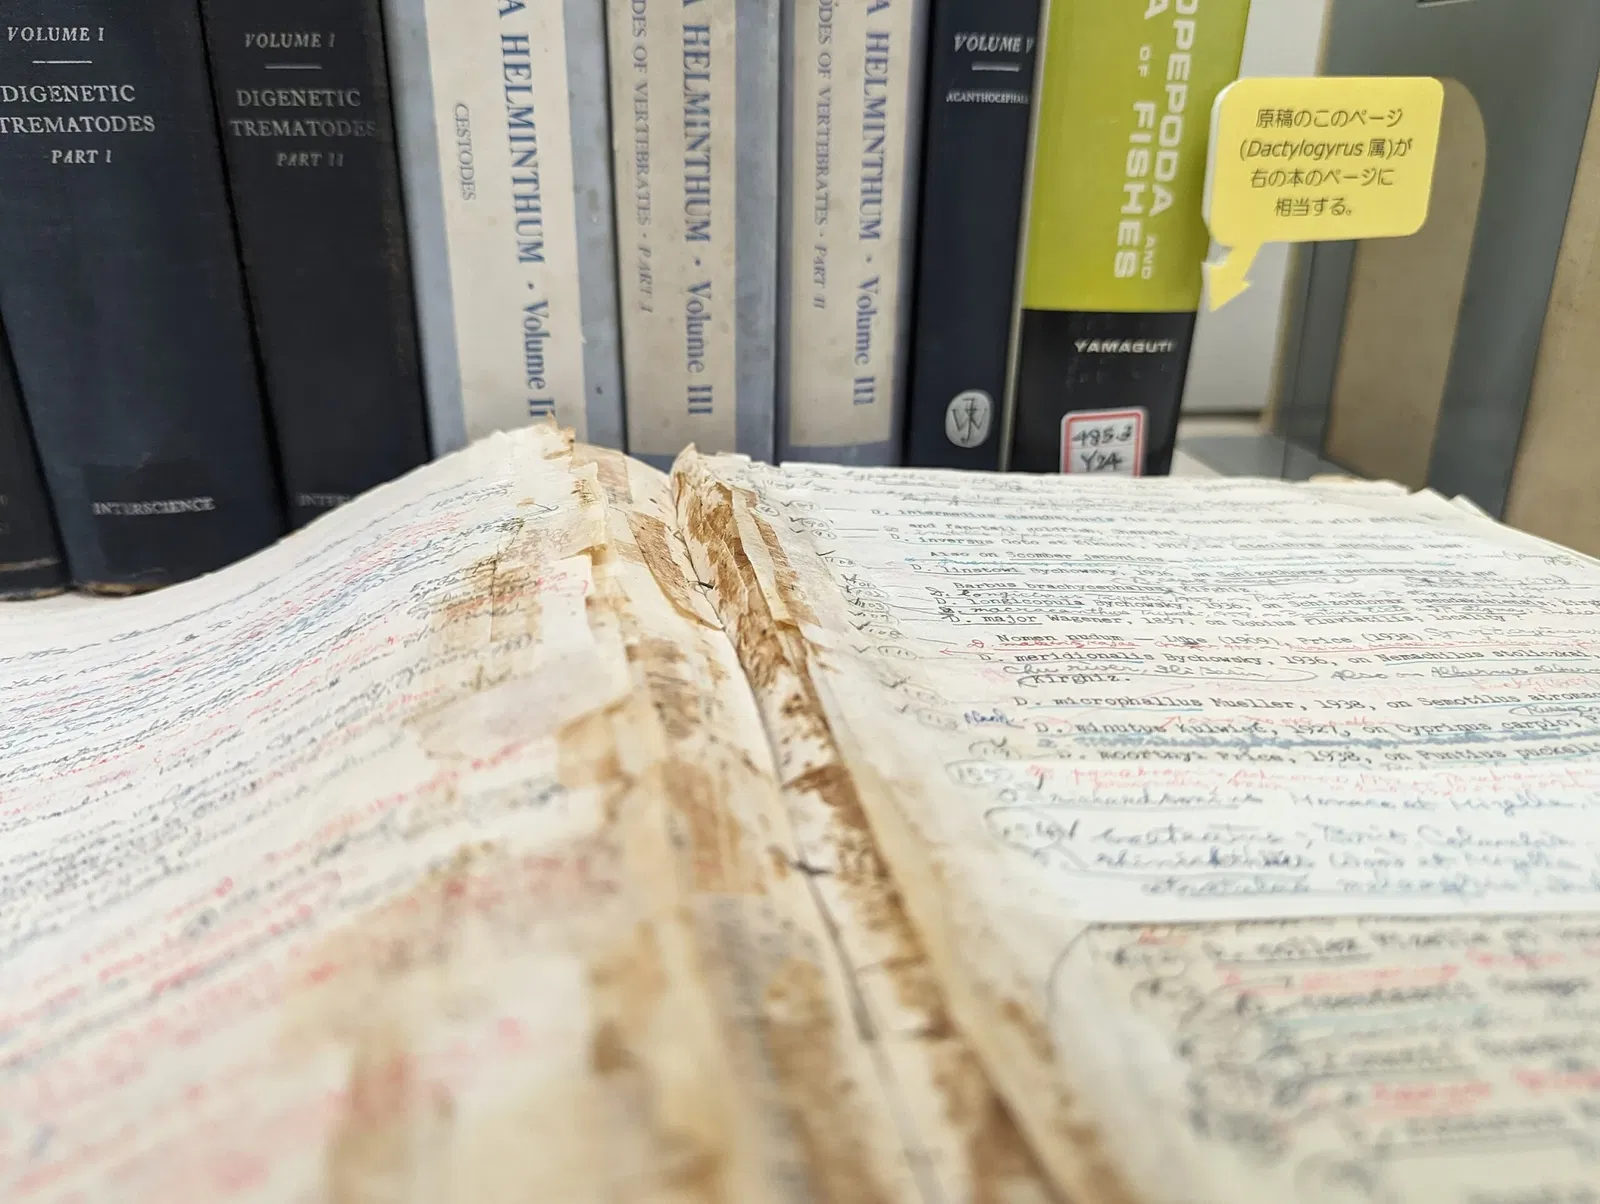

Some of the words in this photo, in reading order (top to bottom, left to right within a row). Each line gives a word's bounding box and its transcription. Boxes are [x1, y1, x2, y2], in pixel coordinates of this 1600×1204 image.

[7, 26, 90, 42] VOLUME
[98, 27, 104, 42] I
[244, 33, 322, 49] VOLUME
[953, 33, 1022, 53] VOLUME
[633, 45, 649, 75] OF
[815, 51, 833, 80] OF
[1137, 44, 1152, 78] OF
[0, 85, 136, 103] DIGENETIC
[236, 89, 362, 107] DIGENETIC
[0, 116, 156, 134] TREMATODES
[230, 119, 377, 137] TREMATODES
[1256, 109, 1404, 129] 原稿のこのページ
[682, 23, 713, 244] HELMINTHUM
[858, 31, 893, 242] HELMINTHUM
[51, 150, 99, 164] PART
[453, 102, 477, 202] CESTODES
[500, 33, 546, 265] HELMINTHUM
[632, 82, 655, 227] VERTEBRATES
[814, 86, 833, 227] VERTEBRATES
[1240, 139, 1363, 161] (Dactylogyrus
[1367, 137, 1413, 158] 属)が
[275, 152, 323, 167] PART
[1250, 168, 1394, 188] 右の本のページに
[1112, 101, 1157, 279] FISHES
[1275, 197, 1353, 217] 相当する。
[1140, 234, 1158, 281] AND
[636, 247, 655, 296] PART
[813, 246, 829, 290] PART
[686, 280, 713, 375] Volume
[853, 276, 882, 366] Volume
[522, 300, 552, 391] Volume
[1074, 339, 1173, 355] YAMAGUTI
[686, 385, 714, 416] III
[852, 376, 878, 406] III
[92, 497, 216, 516] INTERSCIENCE
[1006, 551, 1073, 560] Scomber
[1083, 554, 1164, 562] japonicus
[944, 565, 1019, 573] linstowi
[967, 598, 1086, 606] longicopula
[1095, 600, 1194, 610] Bychowsky,
[949, 614, 972, 623] D.
[982, 615, 1037, 624] major
[1046, 615, 1133, 625] Wagener,
[1140, 617, 1195, 626] 1857,
[1428, 614, 1506, 623] locality
[995, 634, 1057, 642] Nomen
[1065, 633, 1124, 642] nudum
[1297, 637, 1353, 645] Price
[1014, 651, 1155, 662] meridionalis
[1162, 652, 1275, 666] Bychowsky,
[1281, 656, 1338, 666] 1936,
[1374, 650, 1485, 662] Nemachilus
[1032, 674, 1131, 685] Kirghiz.
[1013, 696, 1042, 706] D.
[1053, 696, 1204, 708] microphallus
[1209, 697, 1308, 711] Mueller,
[1314, 699, 1376, 711] 1938,
[1386, 700, 1412, 709] on
[1417, 694, 1521, 706] Semotilus
[1034, 722, 1063, 733] D.
[1074, 722, 1167, 734] minutus
[1285, 723, 1352, 737] 1927,
[1362, 726, 1390, 734] on
[1395, 722, 1493, 736] Cyprinus
[1501, 717, 1583, 731] carpio;
[1385, 753, 1412, 761] on
[1415, 749, 1507, 761] Puntius
